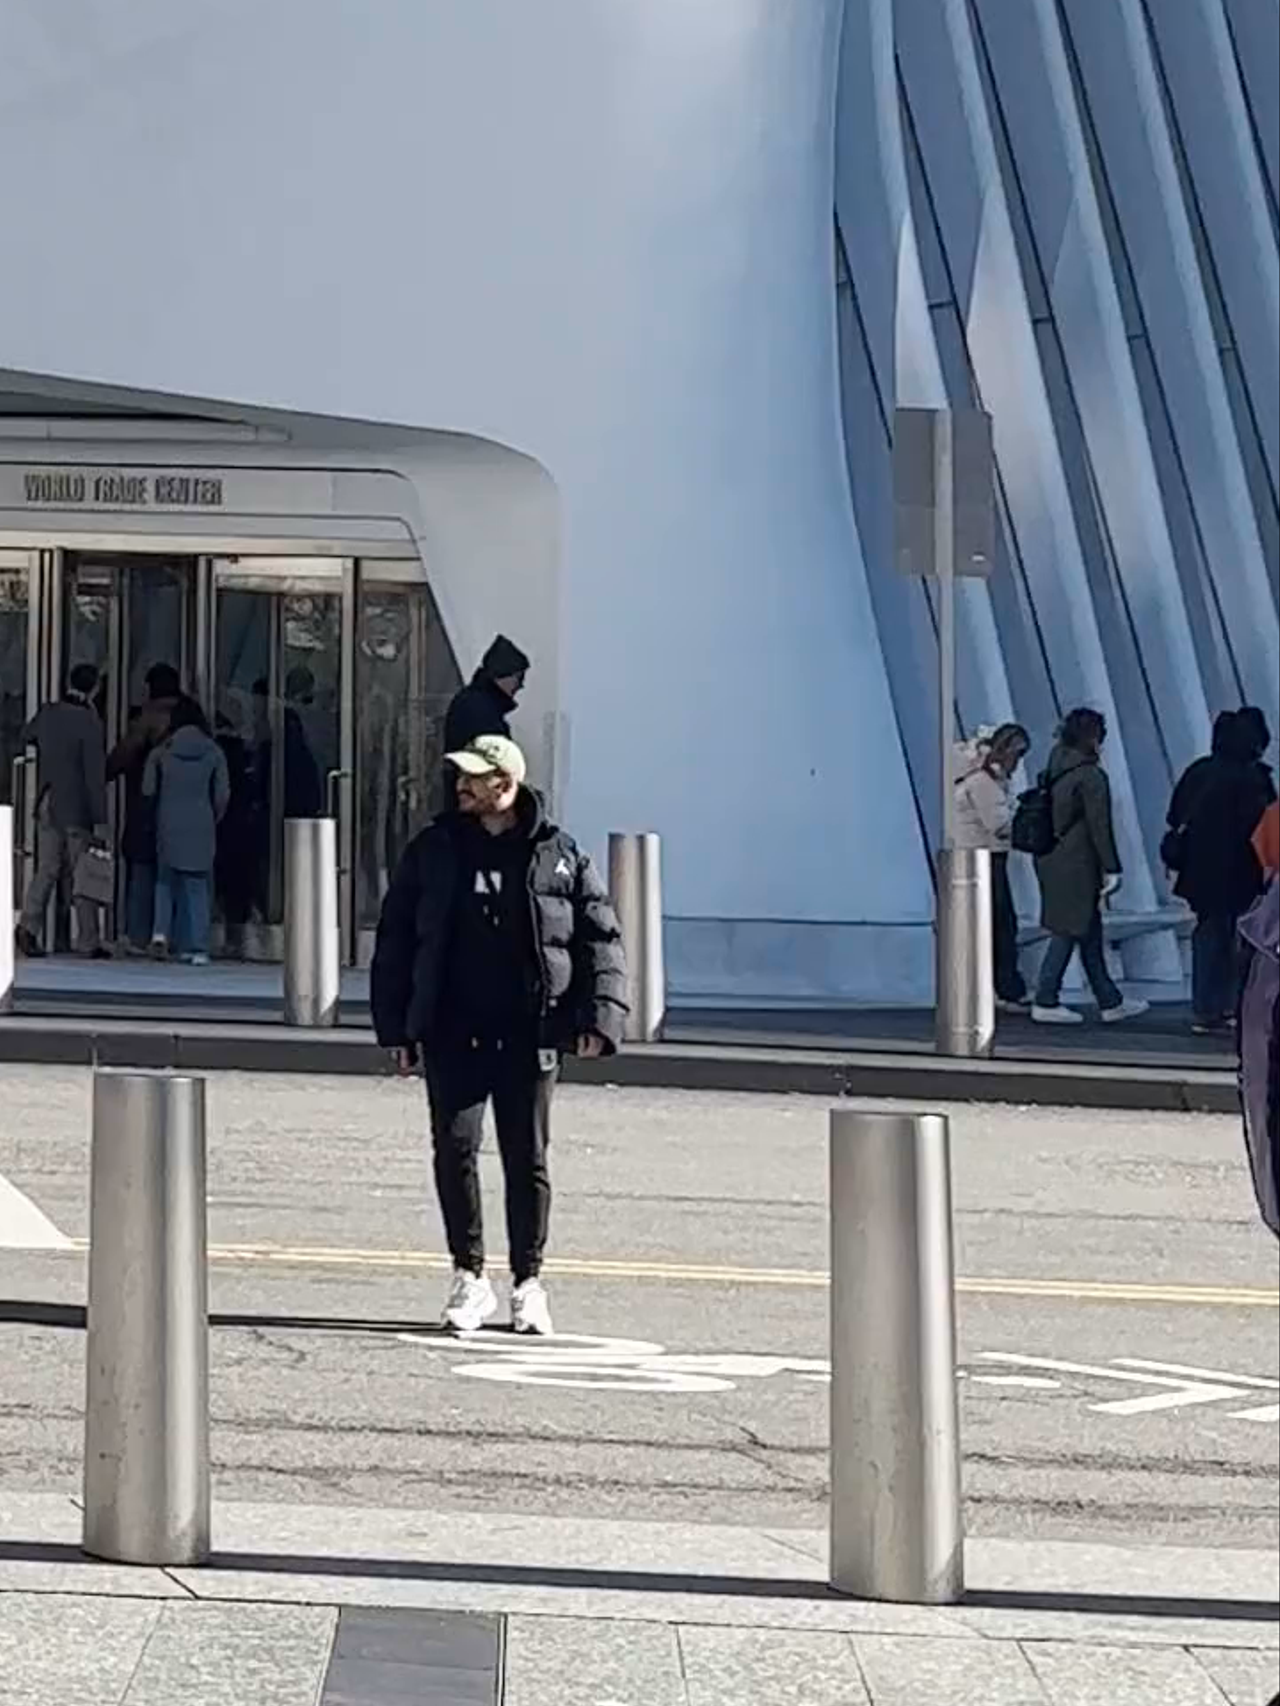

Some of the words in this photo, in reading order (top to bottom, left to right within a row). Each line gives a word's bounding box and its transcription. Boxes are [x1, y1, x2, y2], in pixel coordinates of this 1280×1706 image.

[25, 474, 85, 502] WORLD
[94, 475, 147, 504] TRADE
[154, 476, 223, 505] CENTER
